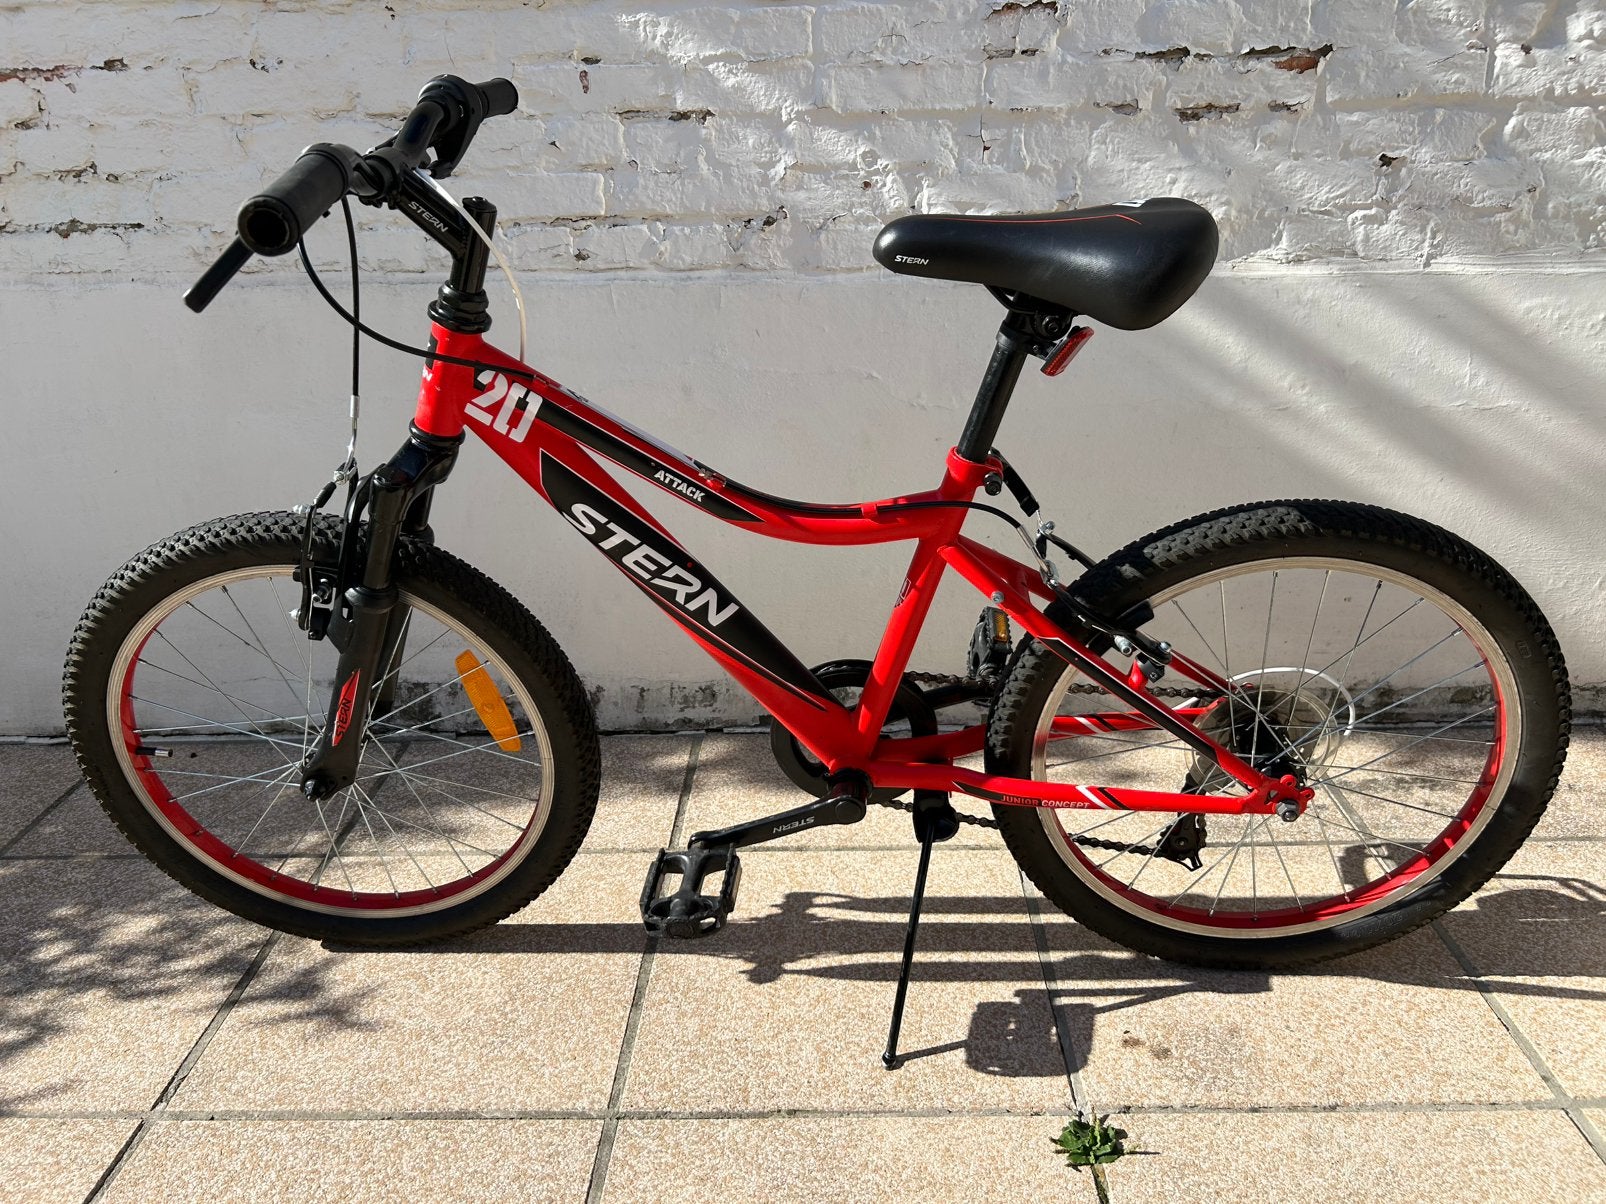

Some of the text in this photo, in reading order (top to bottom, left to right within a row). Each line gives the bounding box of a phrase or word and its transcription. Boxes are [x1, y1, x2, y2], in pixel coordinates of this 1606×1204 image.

[408, 201, 448, 232] STERN
[895, 254, 929, 265] STERN
[464, 369, 543, 443] 20
[653, 469, 706, 502] ATTACK
[563, 503, 740, 627] STERN
[336, 699, 351, 738] STERN
[1001, 794, 1090, 810] JUNIOR CONCEPT
[772, 815, 815, 834] STERN
